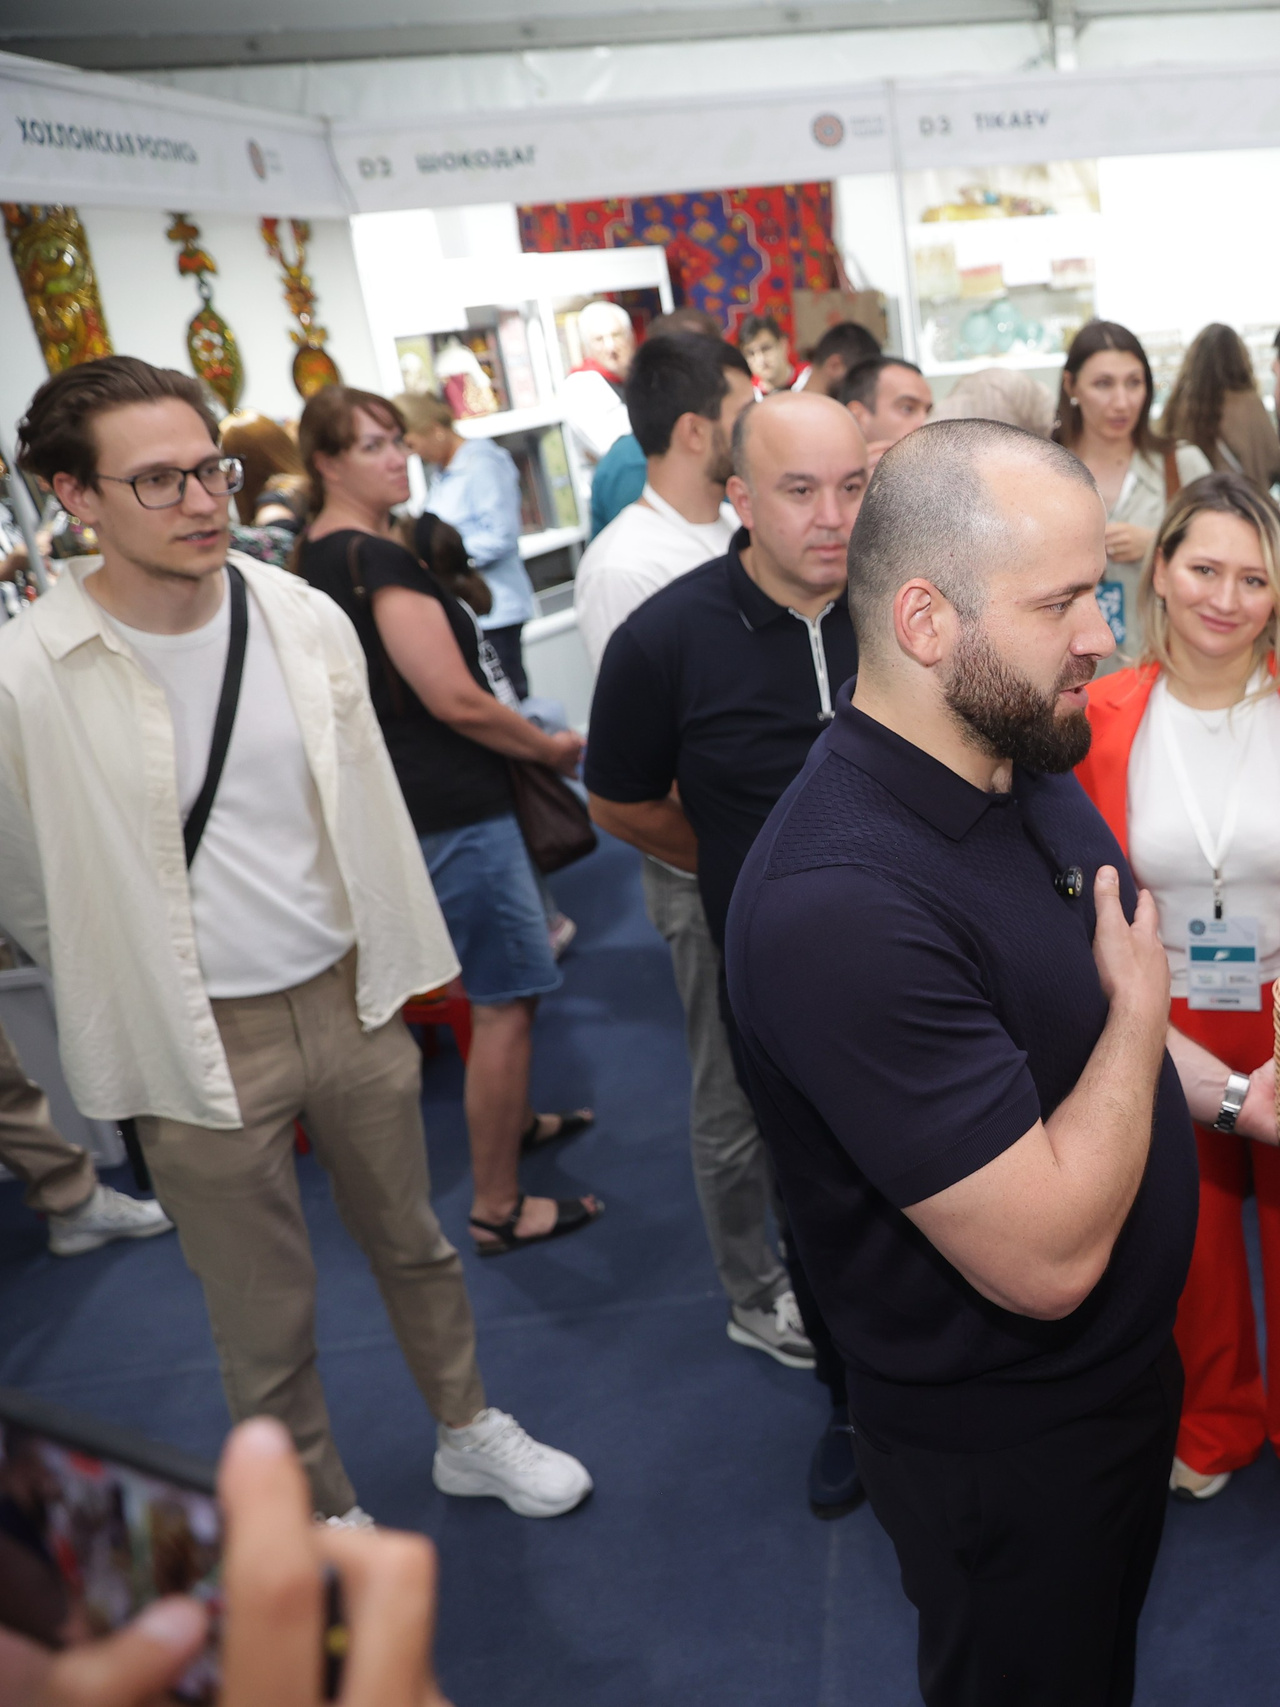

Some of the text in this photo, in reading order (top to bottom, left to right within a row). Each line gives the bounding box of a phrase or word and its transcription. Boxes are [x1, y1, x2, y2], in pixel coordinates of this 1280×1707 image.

[974, 107, 1050, 133] TIKAEV
[15, 115, 199, 165] ХОХЛОМСКАЯ РОСПИСЬ
[415, 144, 537, 174] ШОКОДАГ
